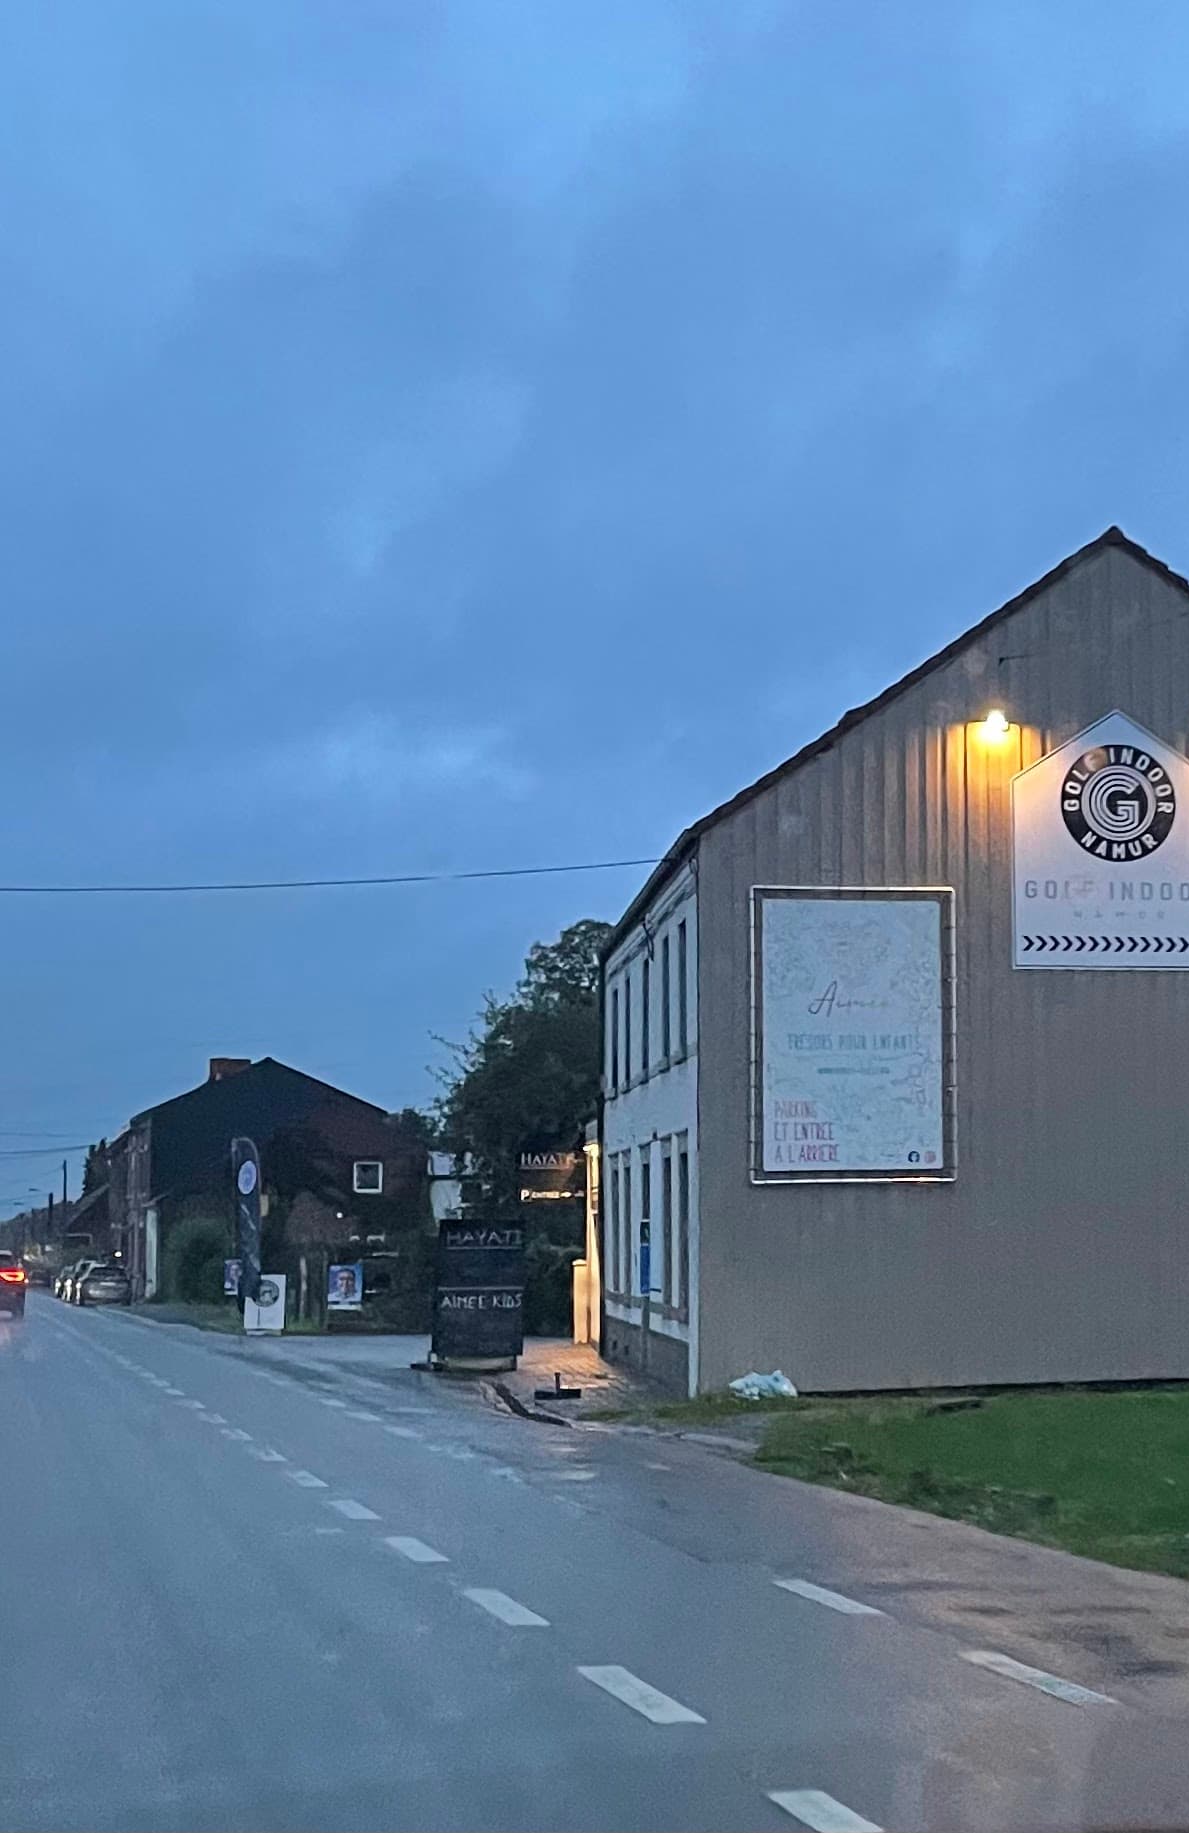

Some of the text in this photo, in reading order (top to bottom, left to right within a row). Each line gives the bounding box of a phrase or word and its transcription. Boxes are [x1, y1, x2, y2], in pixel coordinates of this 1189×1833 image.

[1108, 747, 1174, 813] INDOOR
[1080, 831, 1159, 859] NAMUR
[774, 1121, 788, 1141] ET
[447, 1229, 523, 1246] HAYATI
[492, 1293, 523, 1310] KIDS
